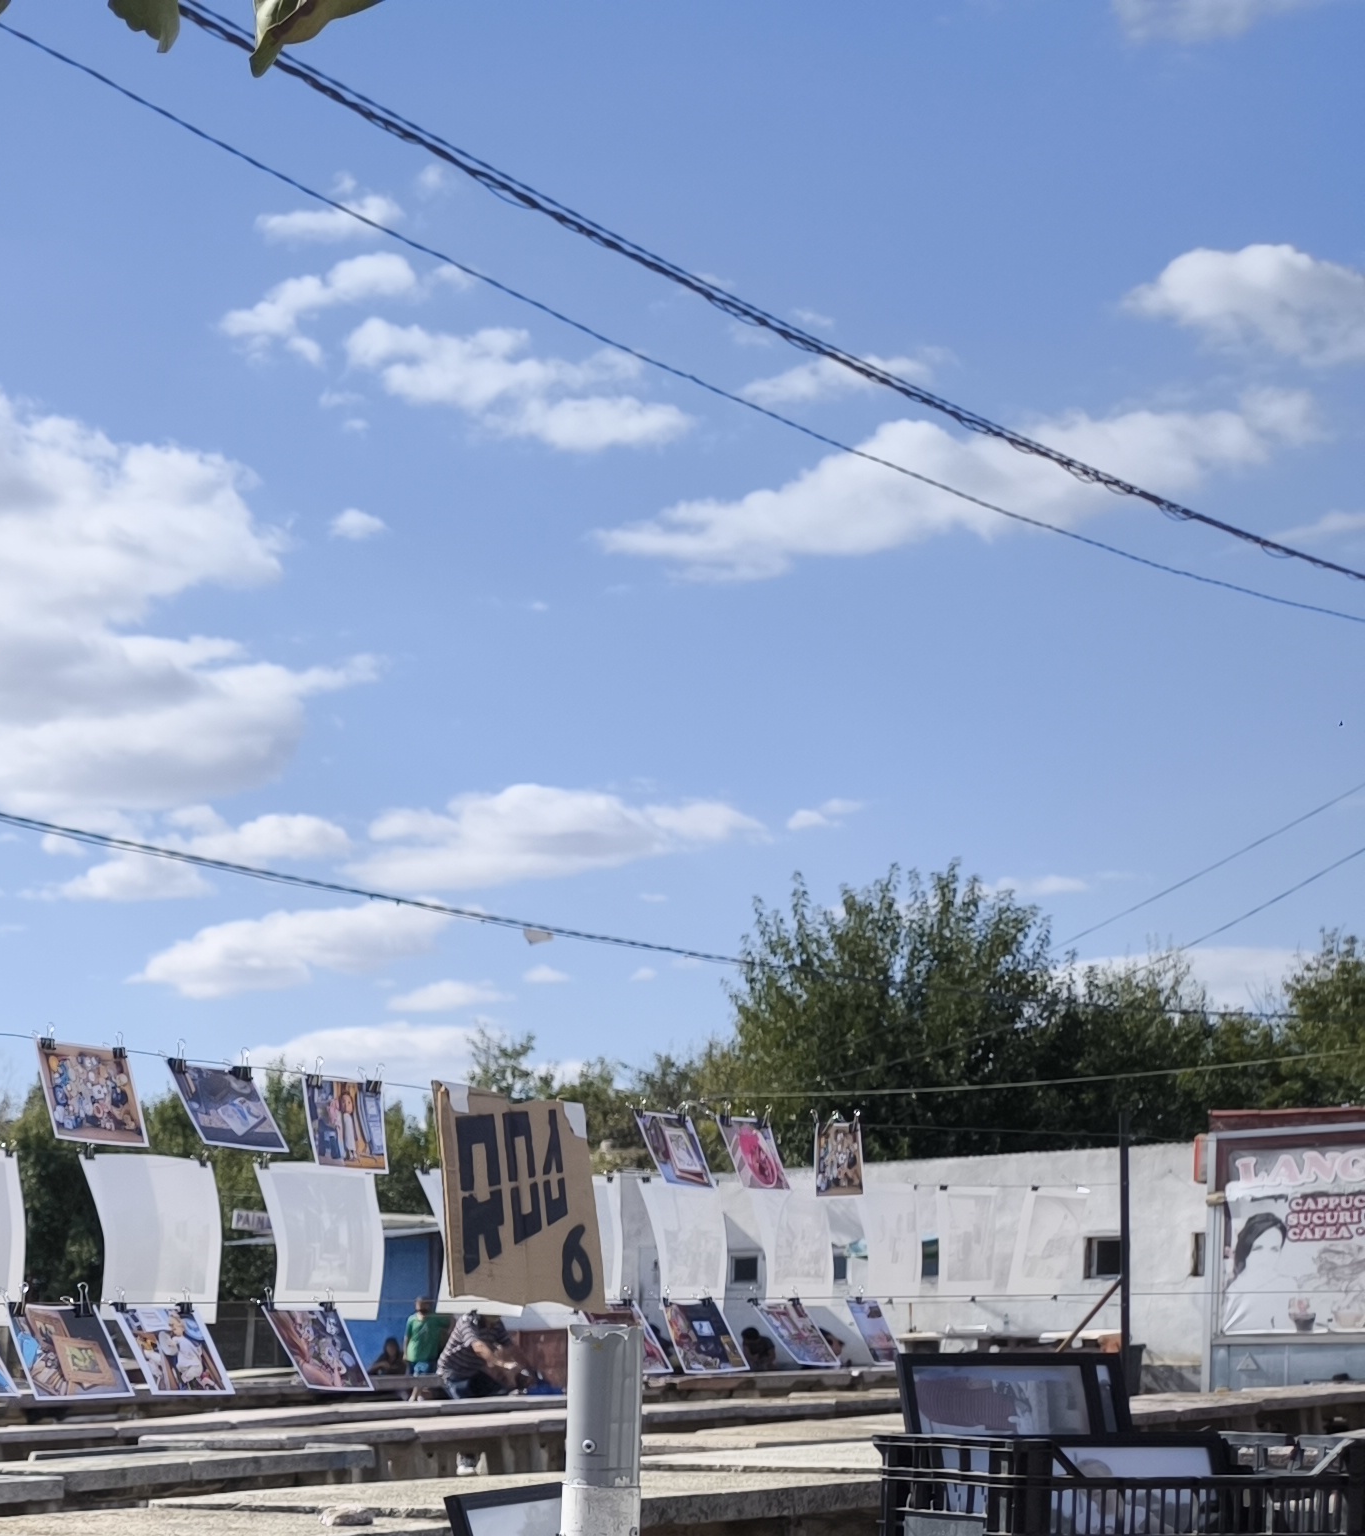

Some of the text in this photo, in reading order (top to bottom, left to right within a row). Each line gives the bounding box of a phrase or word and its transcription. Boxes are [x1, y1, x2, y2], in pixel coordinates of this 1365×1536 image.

[1286, 1210, 1360, 1226] SUCURI
[1287, 1225, 1352, 1240] CAFEA
[562, 1224, 593, 1302] 6
